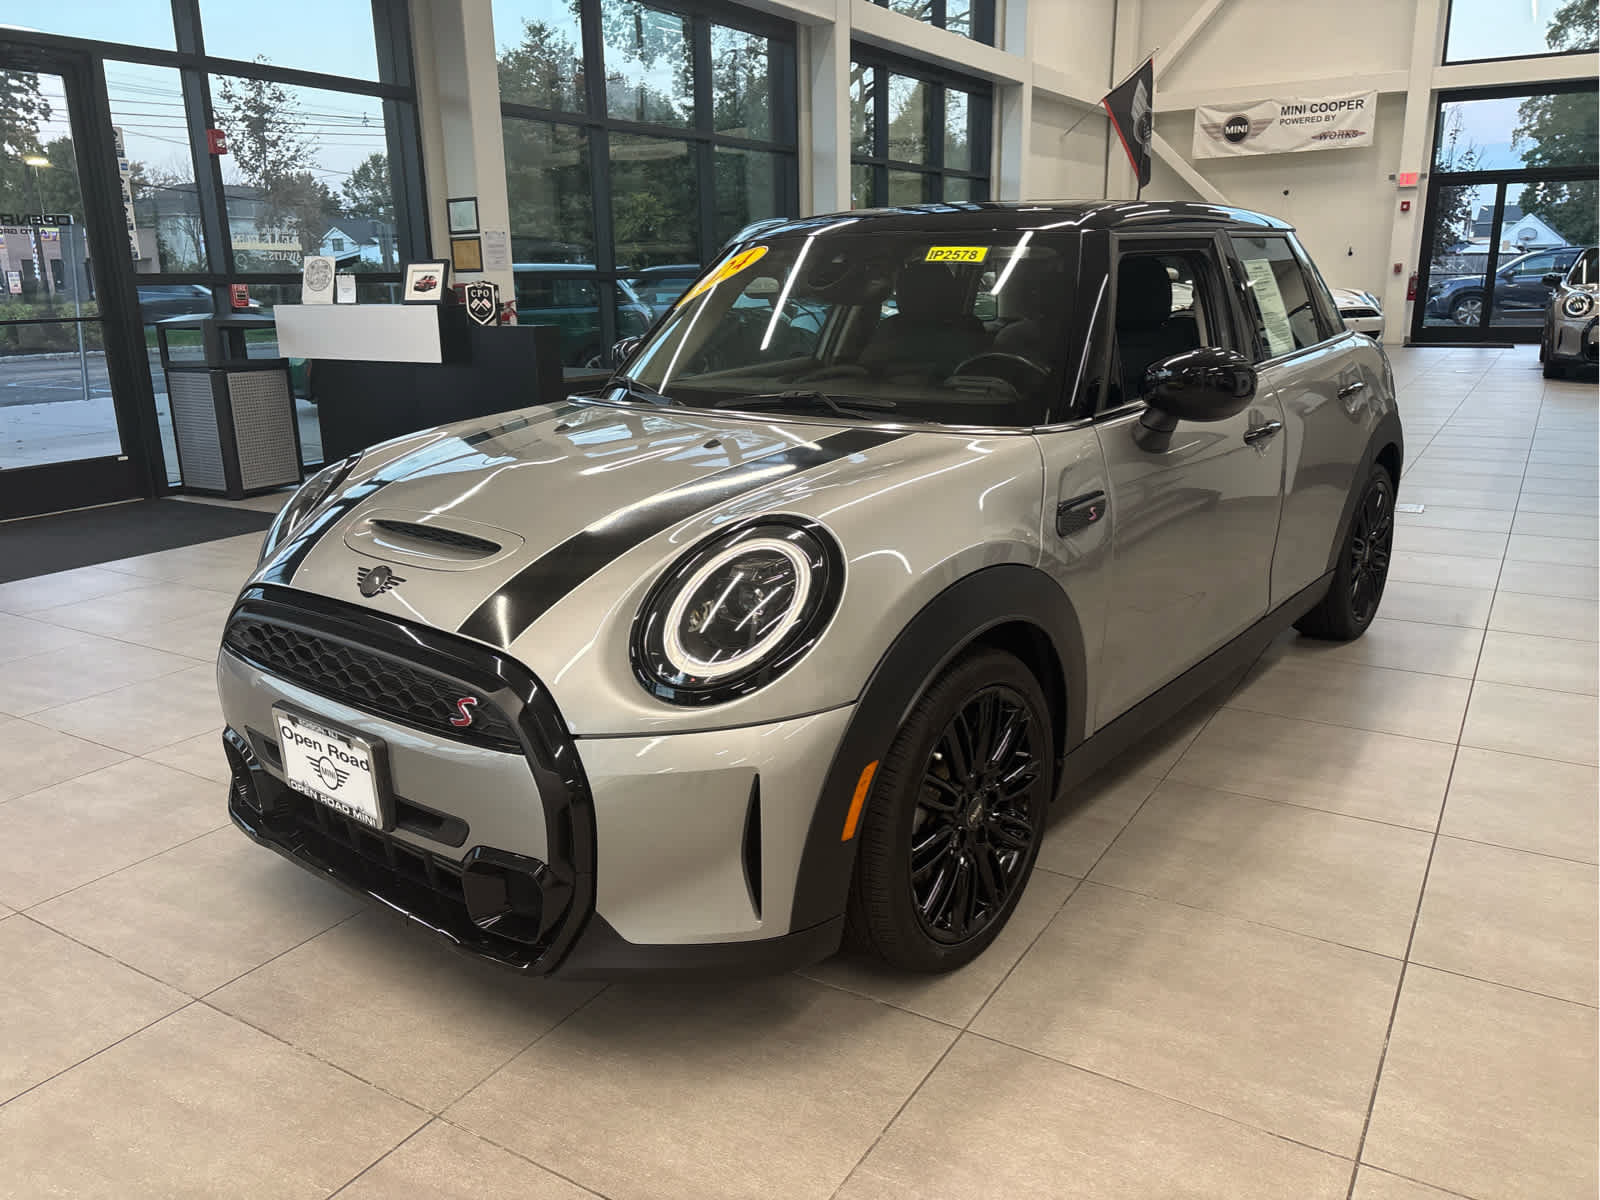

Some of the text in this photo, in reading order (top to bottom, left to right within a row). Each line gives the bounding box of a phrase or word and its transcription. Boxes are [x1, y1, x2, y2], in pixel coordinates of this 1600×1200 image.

[1280, 99, 1365, 116] MINI COOPER
[1279, 114, 1337, 126] POWERED BY
[1225, 123, 1248, 136] MINI
[927, 249, 979, 260] IP2578
[470, 289, 490, 298] CPO
[1087, 505, 1097, 521] S
[449, 696, 477, 727] S
[281, 725, 370, 771] Open Road
[321, 766, 336, 780] MINI
[290, 780, 377, 828] OPEN ROAD MINI
